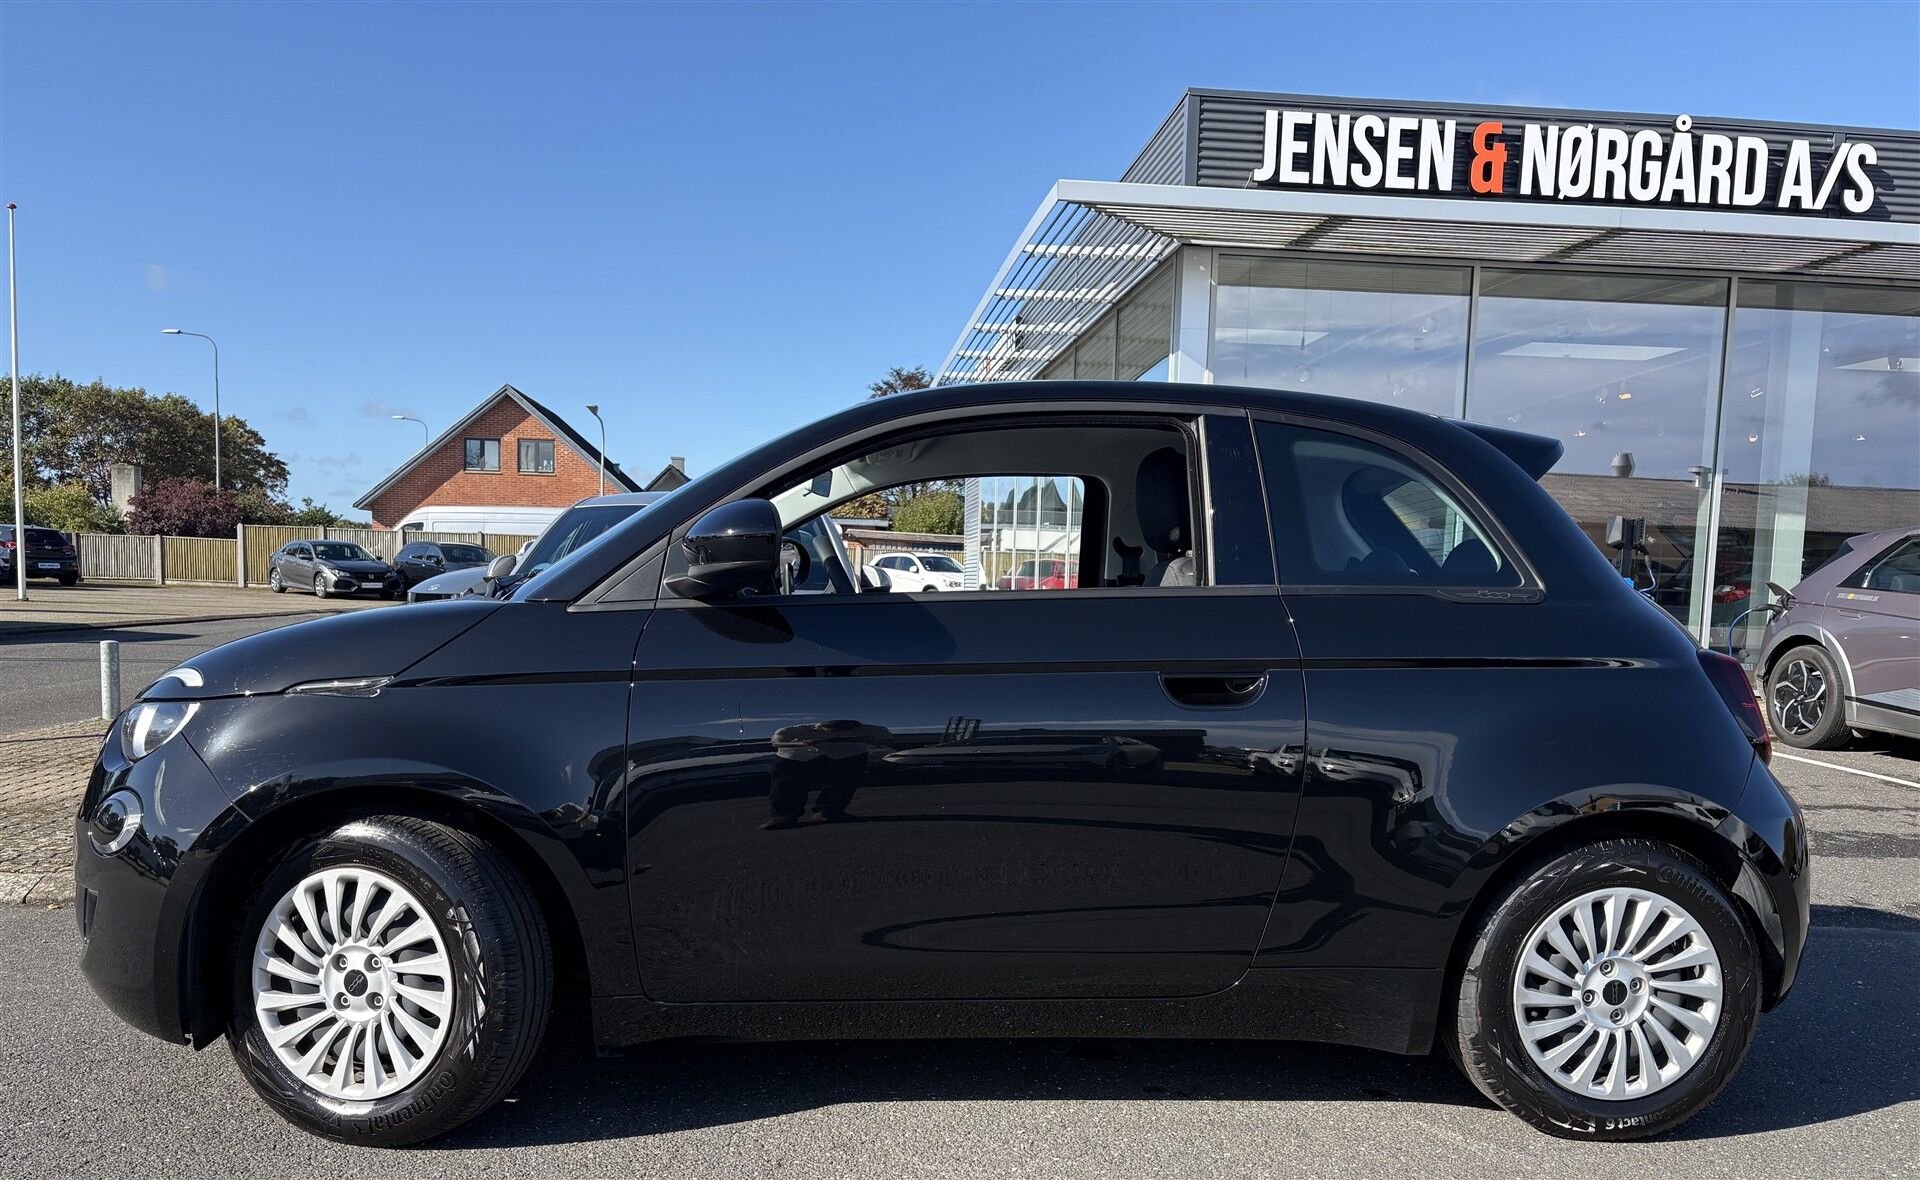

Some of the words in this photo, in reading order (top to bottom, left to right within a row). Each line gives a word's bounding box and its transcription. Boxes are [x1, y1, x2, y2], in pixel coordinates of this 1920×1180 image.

[1253, 109, 1457, 192] JENSEN
[1470, 121, 1508, 194] &
[1519, 114, 1769, 206] NØRGÅRD
[1777, 139, 1878, 214] A/S
[367, 1070, 457, 1136] Continental
